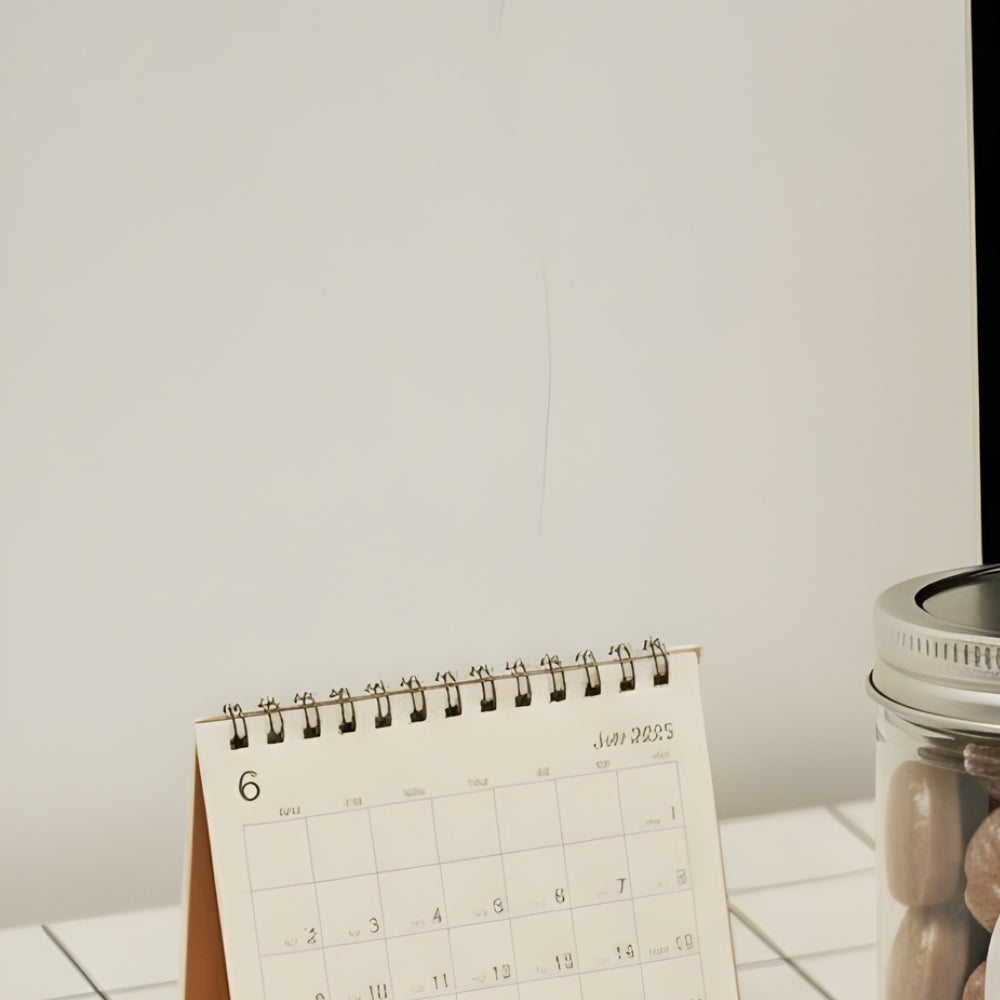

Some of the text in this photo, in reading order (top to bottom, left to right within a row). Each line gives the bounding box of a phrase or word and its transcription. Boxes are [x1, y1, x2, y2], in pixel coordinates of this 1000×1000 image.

[239, 770, 261, 802] 6
[368, 917, 380, 933] 3
[432, 907, 442, 923] 4
[616, 878, 627, 894] 7
[432, 972, 449, 990] 11
